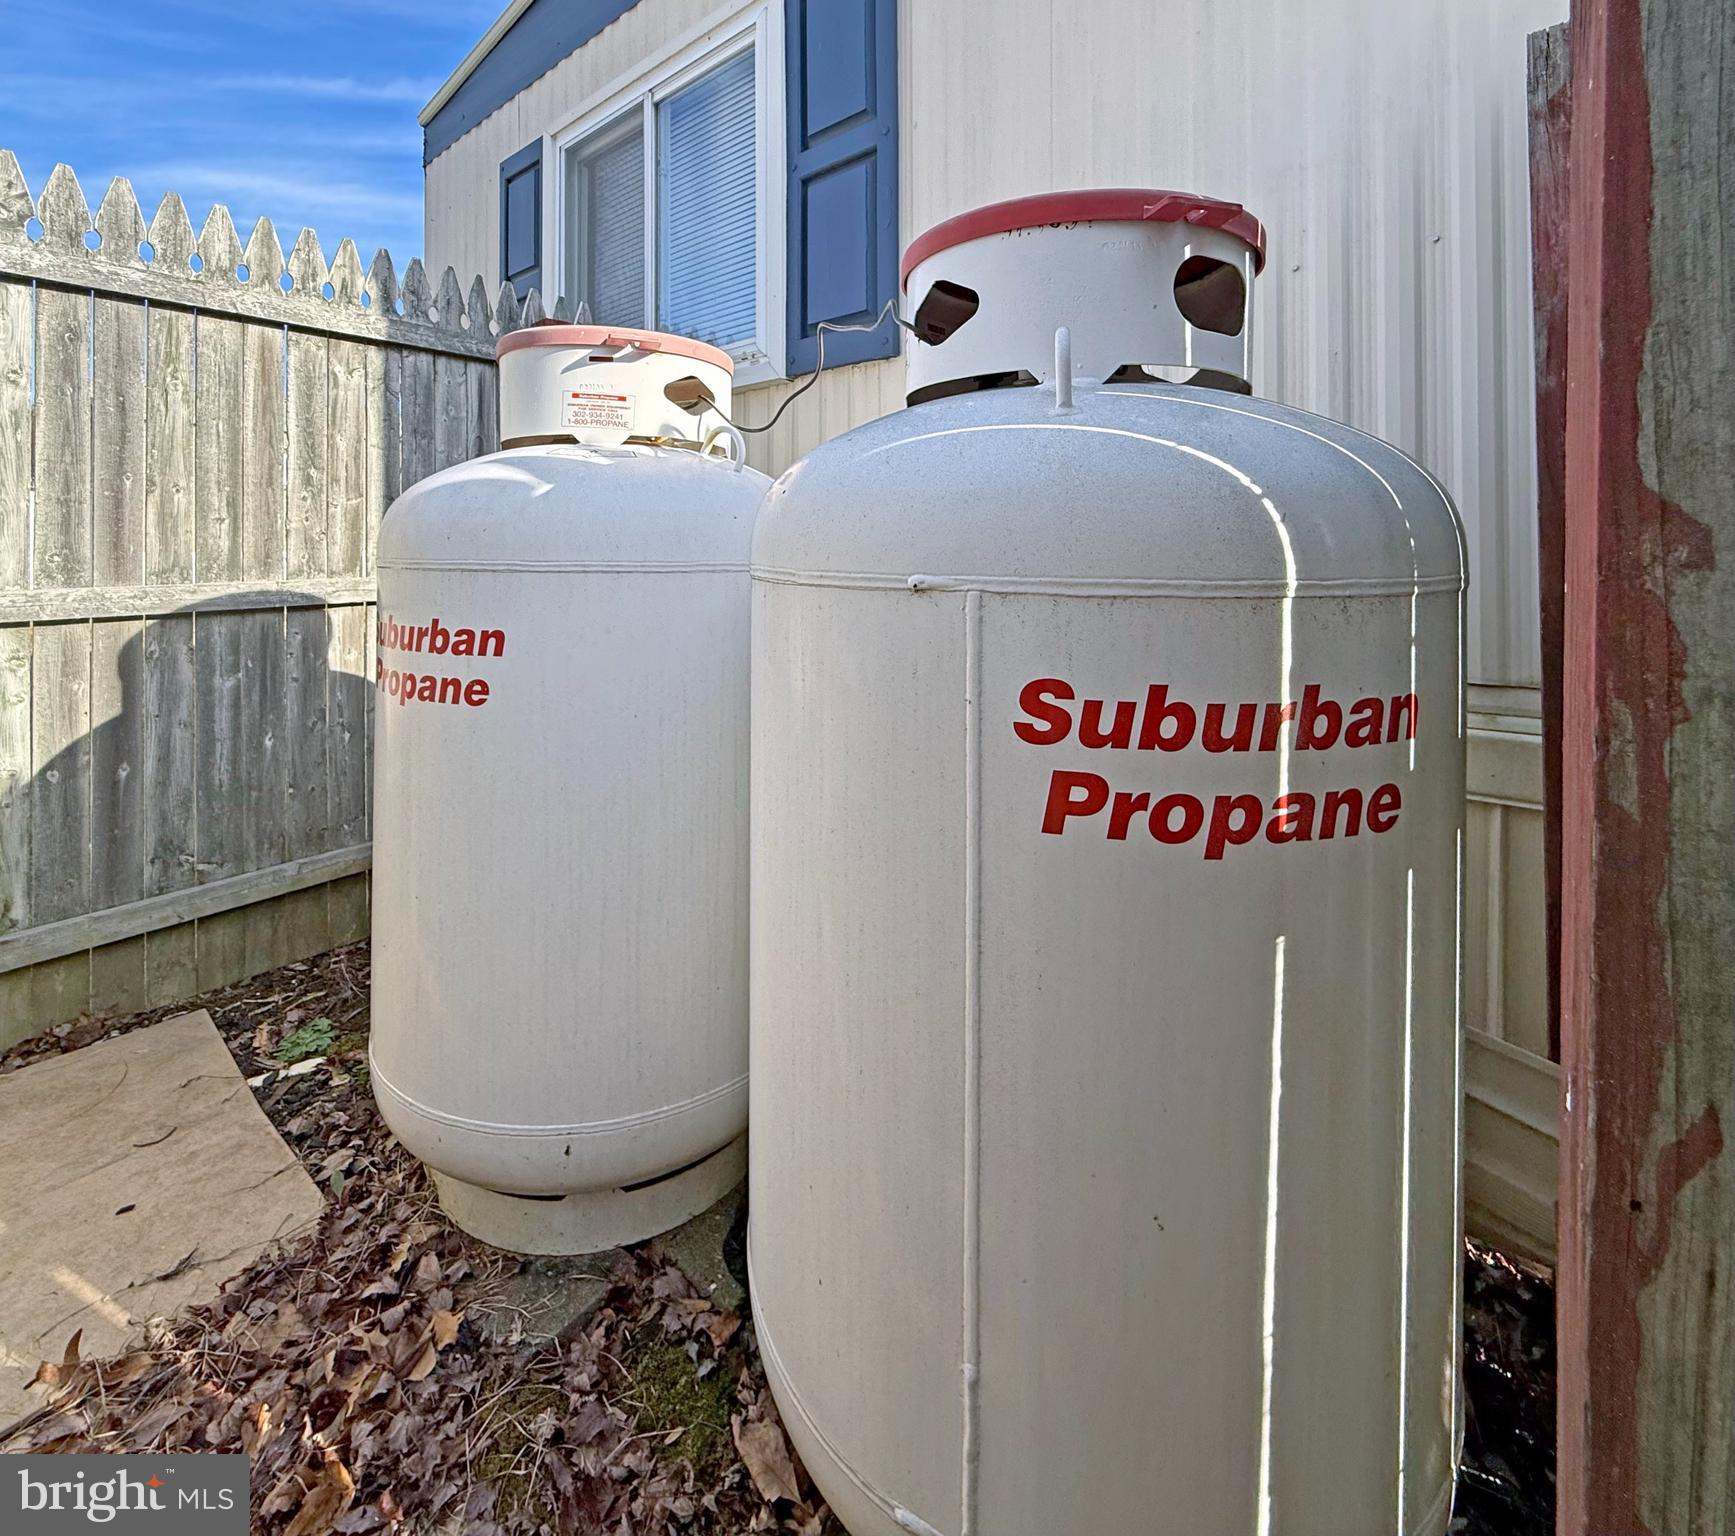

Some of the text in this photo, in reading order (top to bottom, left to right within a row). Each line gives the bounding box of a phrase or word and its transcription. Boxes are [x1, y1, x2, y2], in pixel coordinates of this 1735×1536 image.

[567, 418, 630, 429] 1-800-PROPANE
[572, 411, 623, 420] 302-934-9241
[377, 614, 505, 657] uburban
[1014, 678, 1418, 752] Suburban
[1041, 770, 1402, 860] Propane
